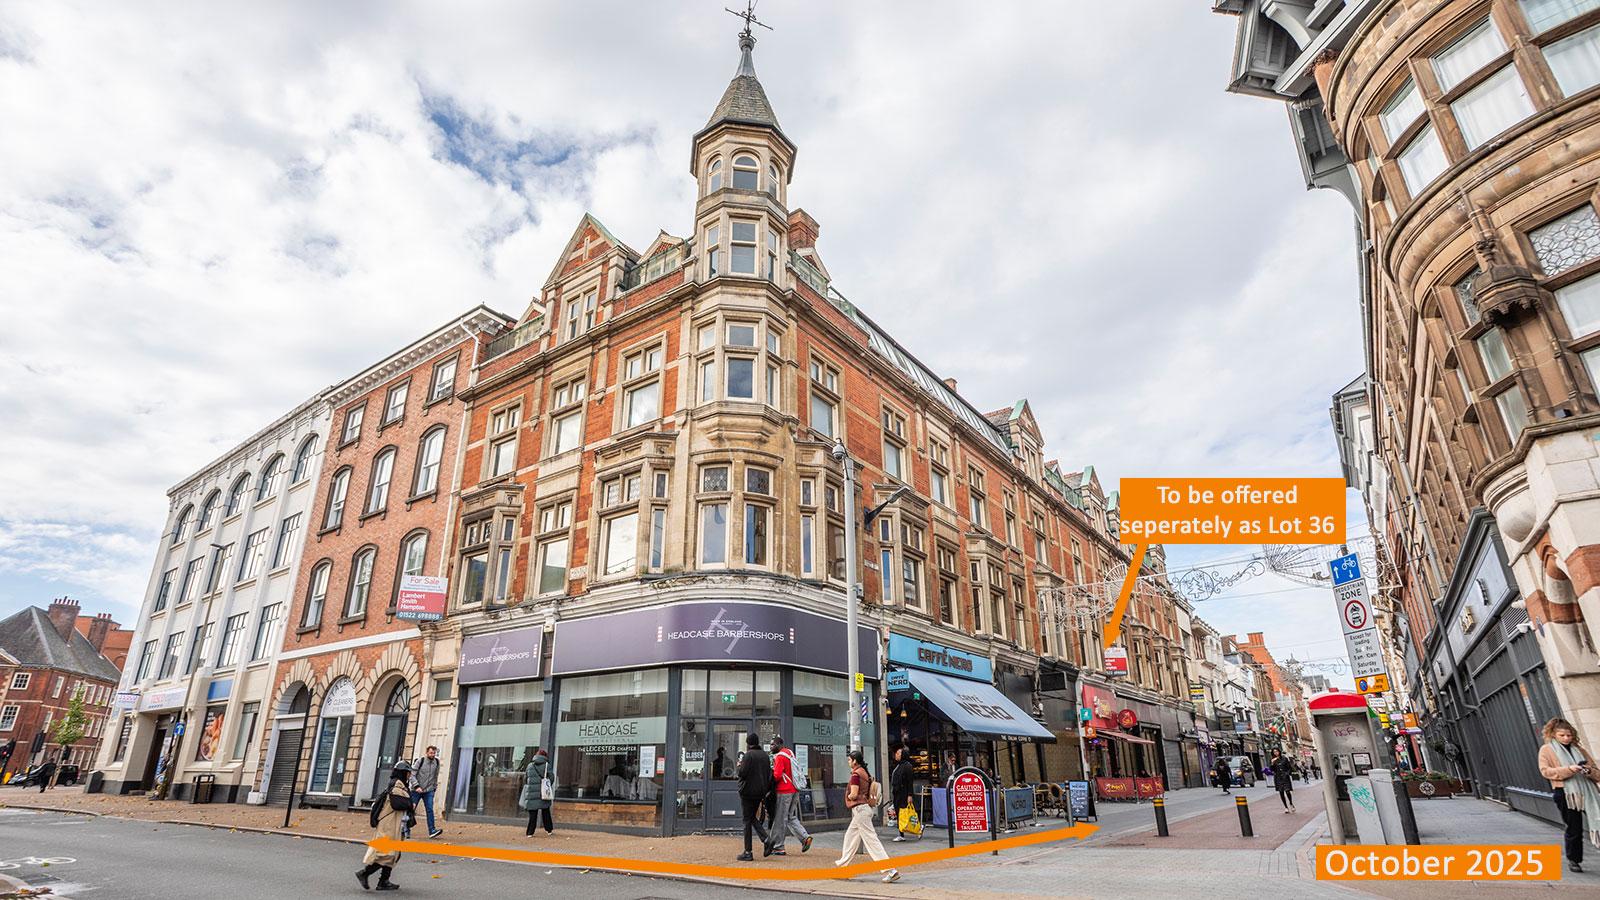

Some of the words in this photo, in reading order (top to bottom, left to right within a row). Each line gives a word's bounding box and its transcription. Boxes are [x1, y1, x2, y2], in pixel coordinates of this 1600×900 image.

[1335, 581, 1364, 592] PEDESTRIAN
[1340, 589, 1362, 600] ZONE
[667, 629, 715, 640] HEADCASE
[716, 629, 785, 641] BARBERSHOPS
[467, 656, 492, 665] HEADCASE
[492, 651, 530, 662] BARBERSHOPS
[948, 655, 973, 673] NERO
[953, 700, 1016, 721] NERO
[578, 721, 639, 737] HEADCASE
[685, 751, 704, 759] CLOSED
